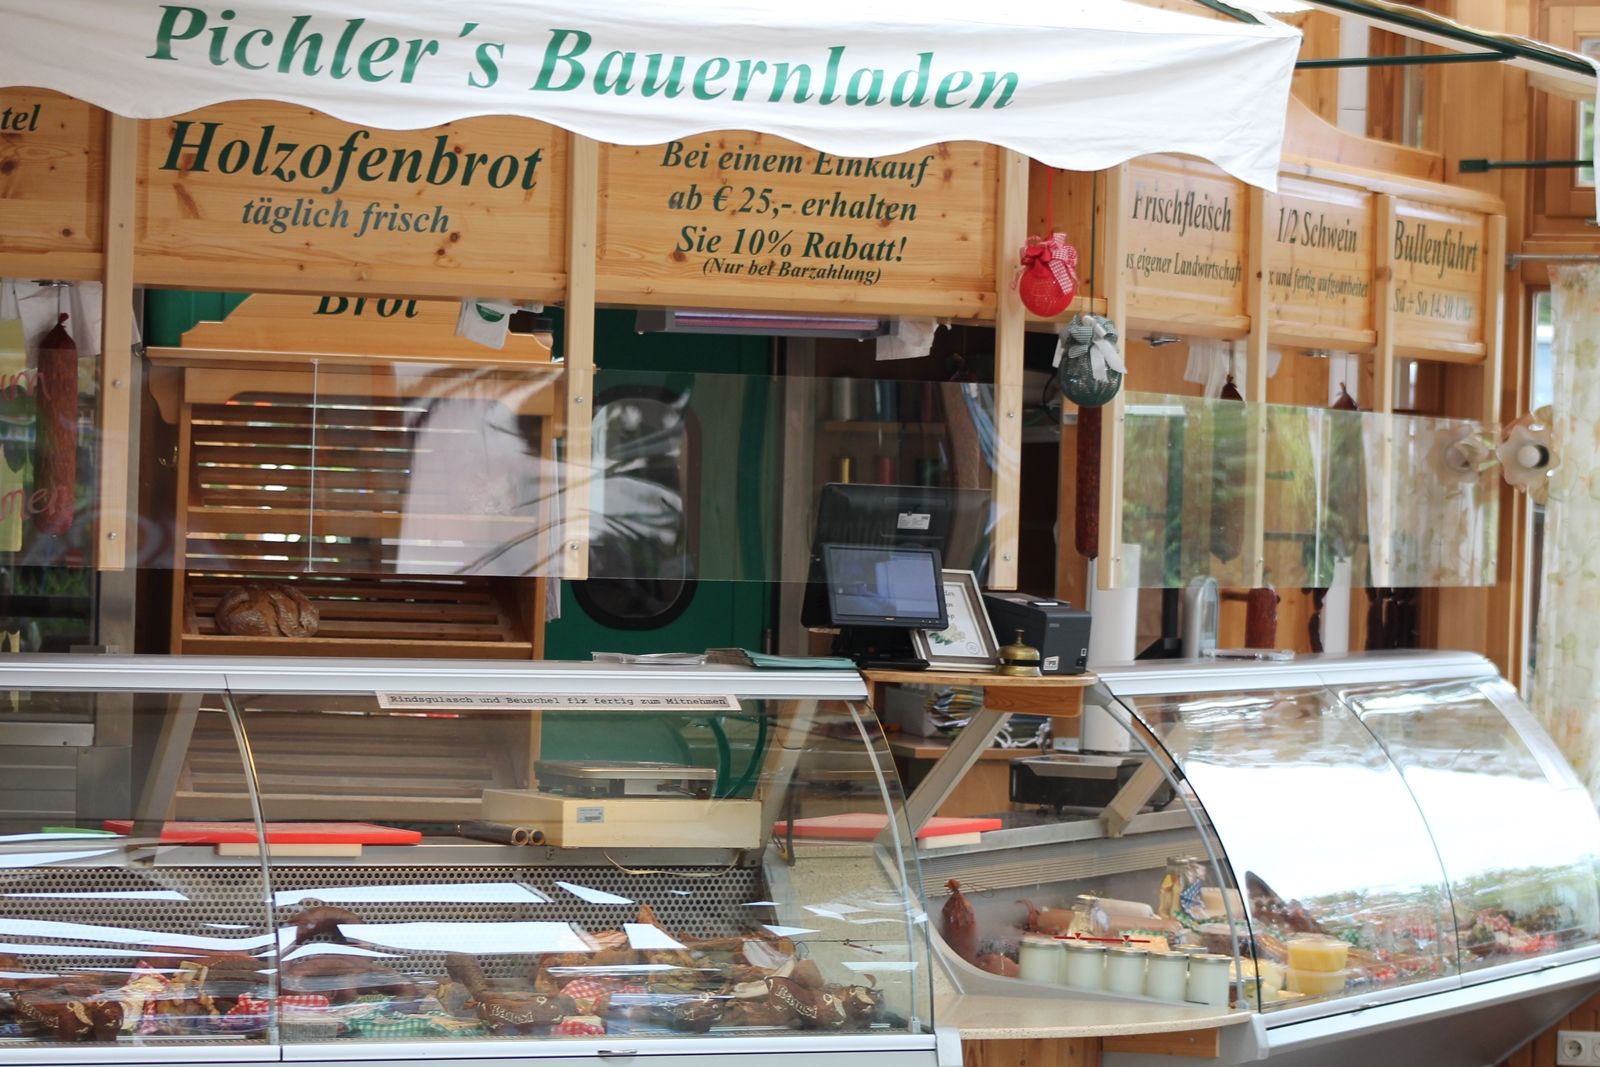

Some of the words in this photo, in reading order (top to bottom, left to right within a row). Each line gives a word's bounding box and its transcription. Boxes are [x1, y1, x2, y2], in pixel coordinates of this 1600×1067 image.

[528, 28, 1020, 111] Bauernladen
[0, 104, 41, 132] tel
[159, 120, 544, 194] Holzofenbrot
[660, 141, 711, 169] Bei
[718, 144, 803, 174] einem
[813, 152, 935, 188] Einkauf
[241, 198, 349, 235] täglich
[354, 204, 450, 239] frisch
[668, 184, 703, 211] ab
[712, 185, 734, 212] €
[738, 187, 793, 219] 25,-
[801, 191, 918, 221] erhalten
[1131, 188, 1232, 238] Frischfleisch
[676, 225, 722, 253] Sie
[730, 228, 794, 257] 10%
[801, 231, 908, 262] Rabatt!
[1275, 207, 1298, 244] 1/2
[1301, 211, 1357, 253] Schwein
[1393, 219, 1479, 280] Bullenfahrt
[702, 257, 744, 276] (Nur
[750, 259, 774, 277] bei
[778, 261, 882, 286] Barzahlung)
[1137, 247, 1172, 278] eigener
[1173, 251, 1243, 289] Landwirtschaft
[1275, 266, 1293, 287] und
[1292, 267, 1316, 297] fertig
